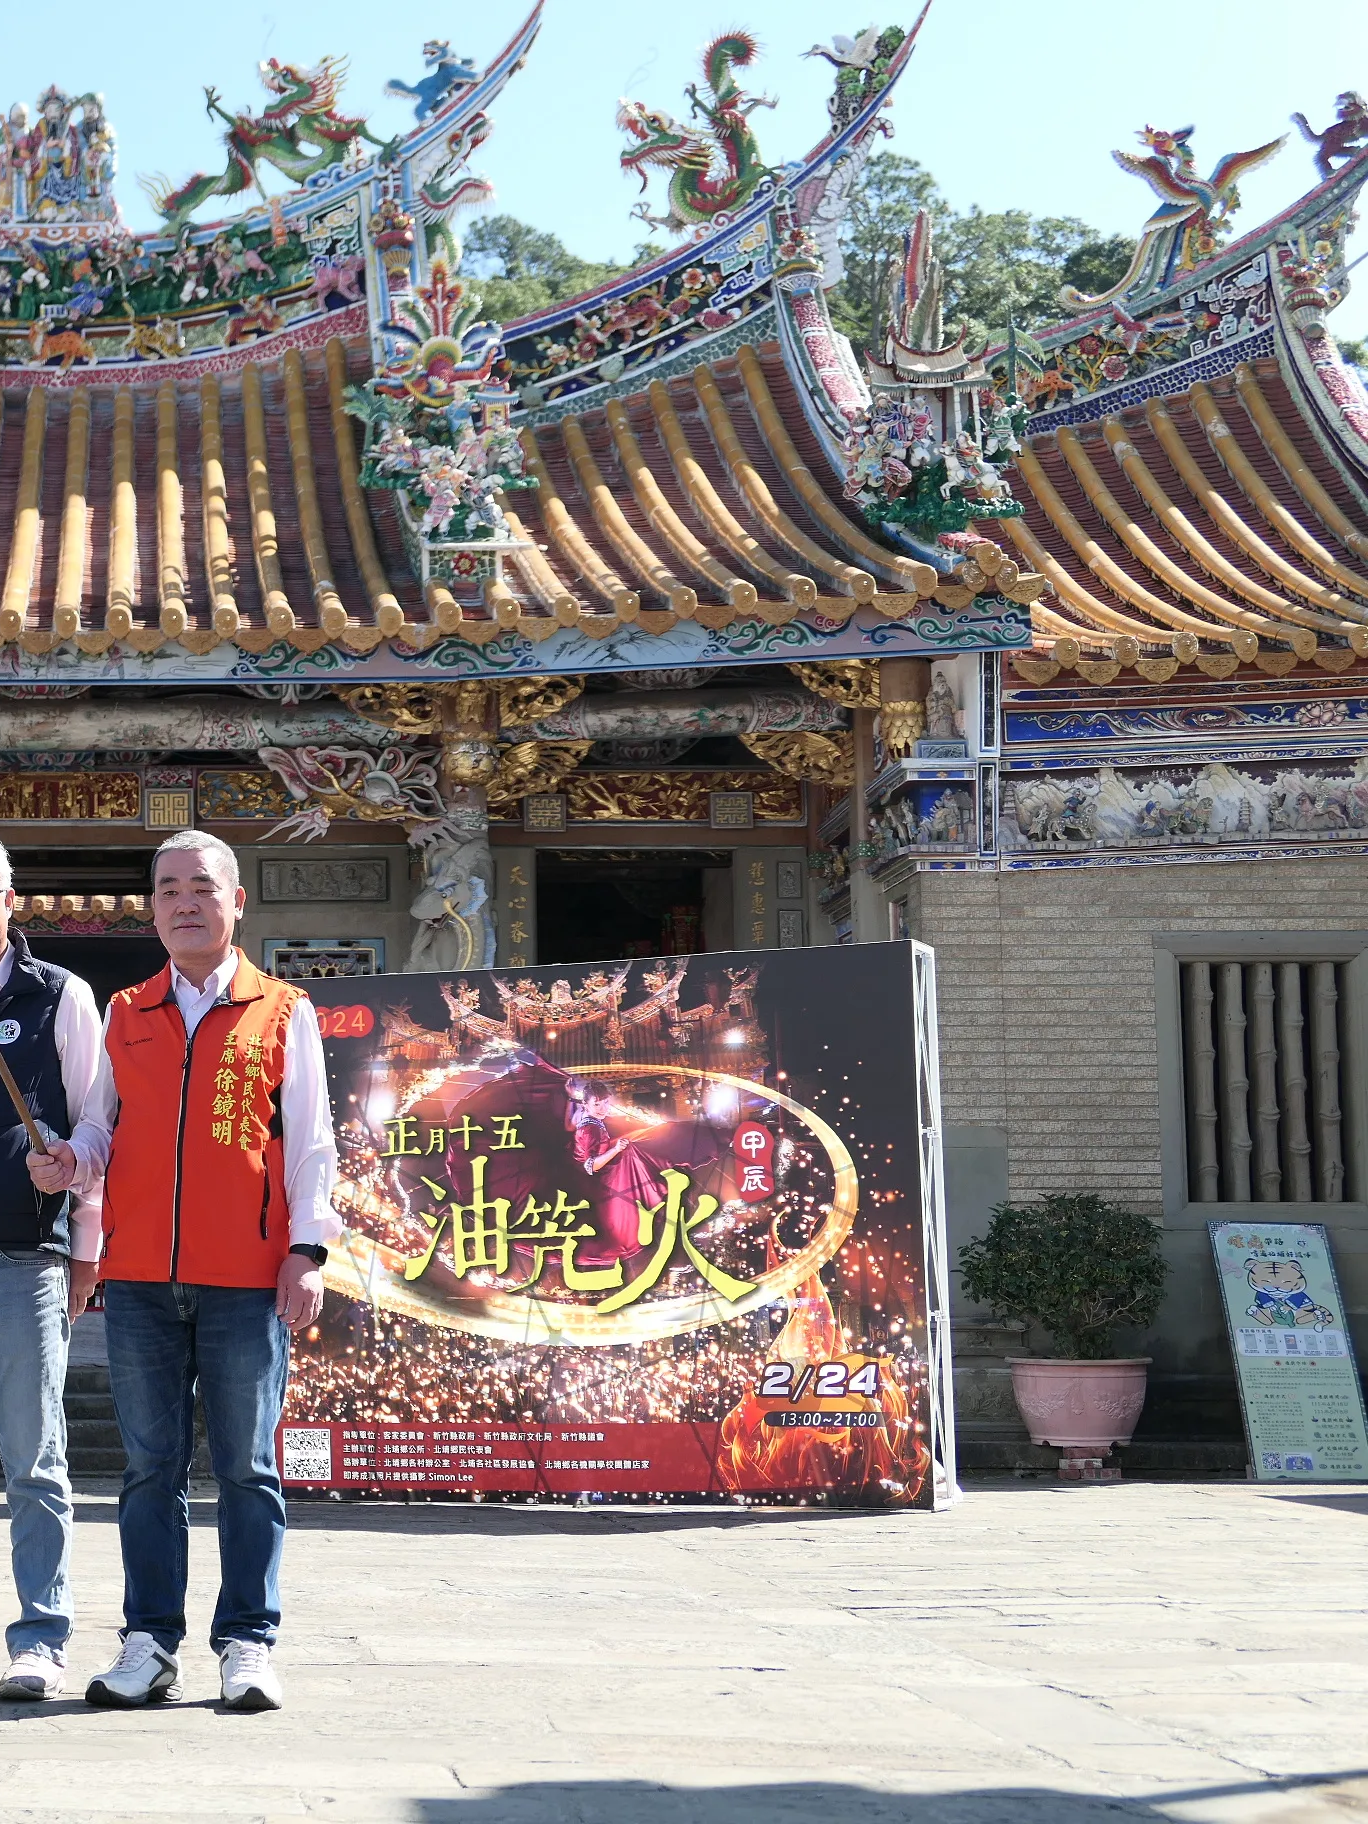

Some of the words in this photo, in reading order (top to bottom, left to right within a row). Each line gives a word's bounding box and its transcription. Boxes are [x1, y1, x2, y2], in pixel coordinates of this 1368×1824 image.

[317, 1010, 366, 1034] 024
[237, 1033, 264, 1151] 北埔鄉民代表會
[380, 1113, 526, 1158] 正月十五
[740, 1130, 771, 1193] 甲辰
[760, 1363, 879, 1402] 2/24
[780, 1412, 877, 1427] 13:00~21:00
[428, 1472, 456, 1482] Simon
[458, 1473, 474, 1482] Lee
